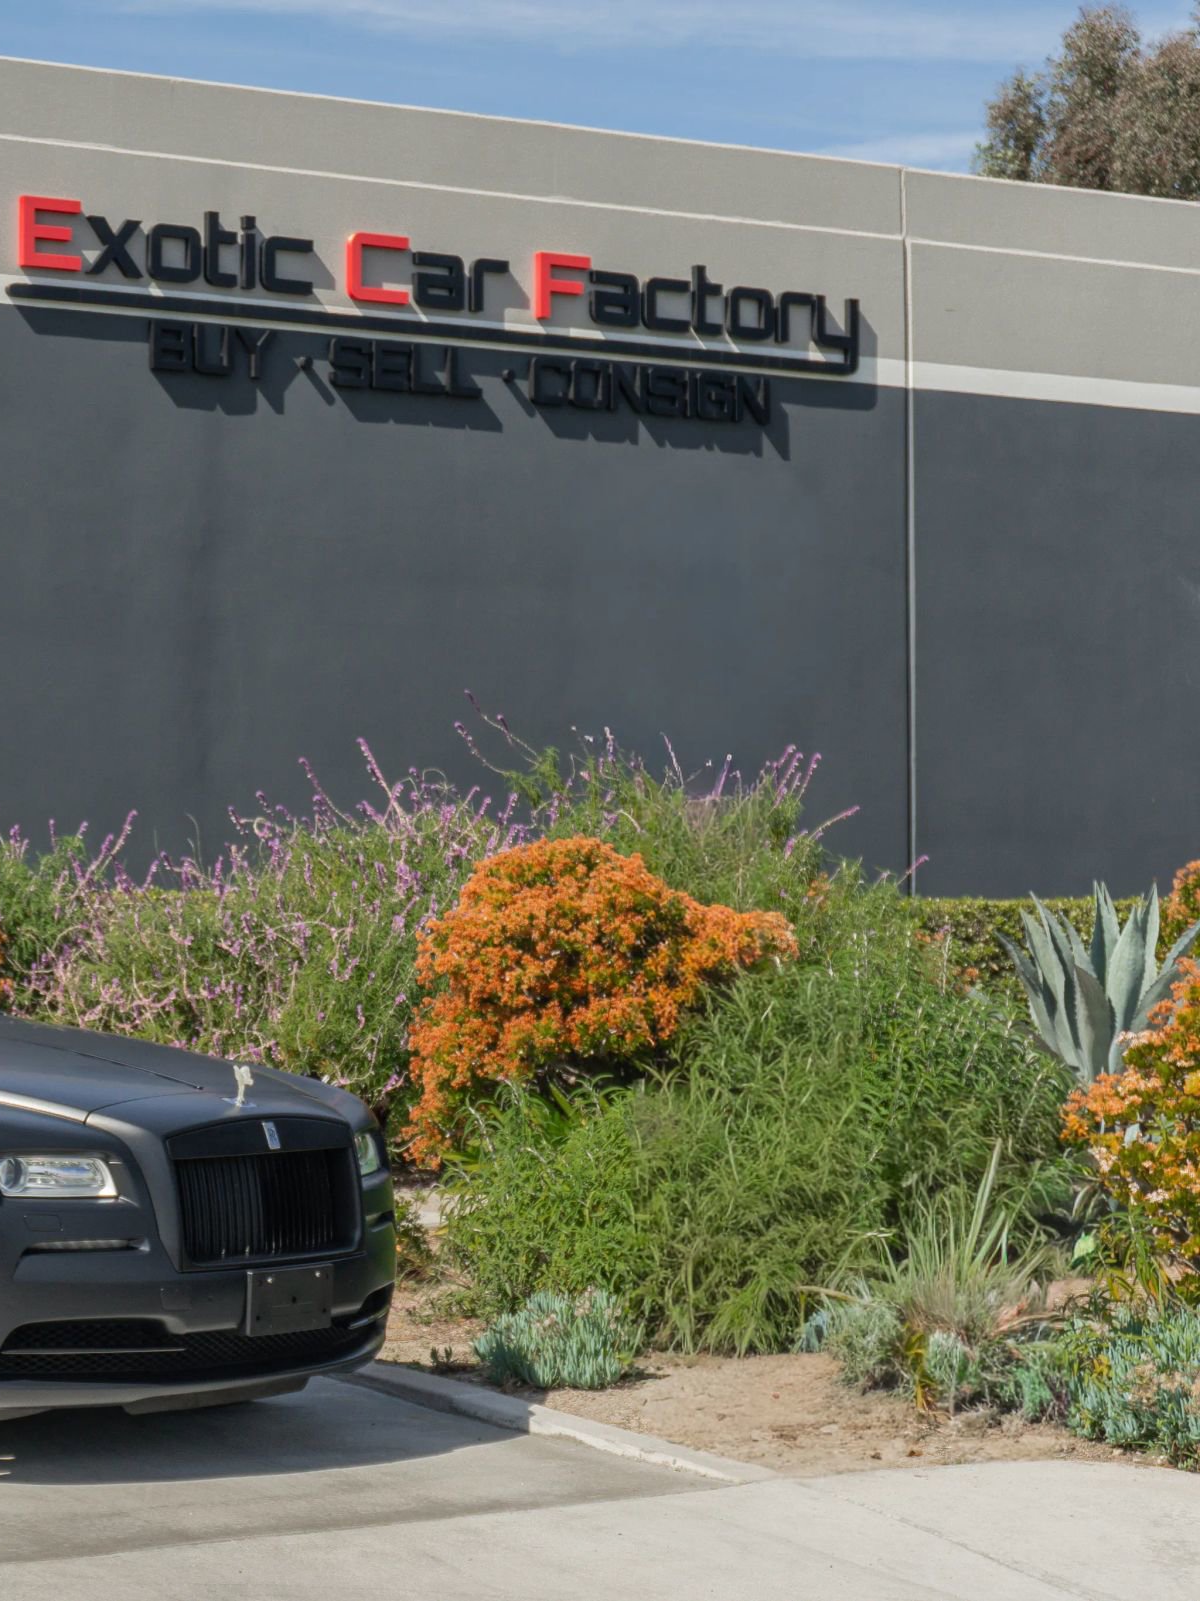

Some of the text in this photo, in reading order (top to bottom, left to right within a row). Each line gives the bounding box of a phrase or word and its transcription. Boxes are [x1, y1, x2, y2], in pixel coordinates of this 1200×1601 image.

[19, 194, 860, 375] Exotic Car Factory
[150, 319, 771, 427] BUY SELL CONSIGN
